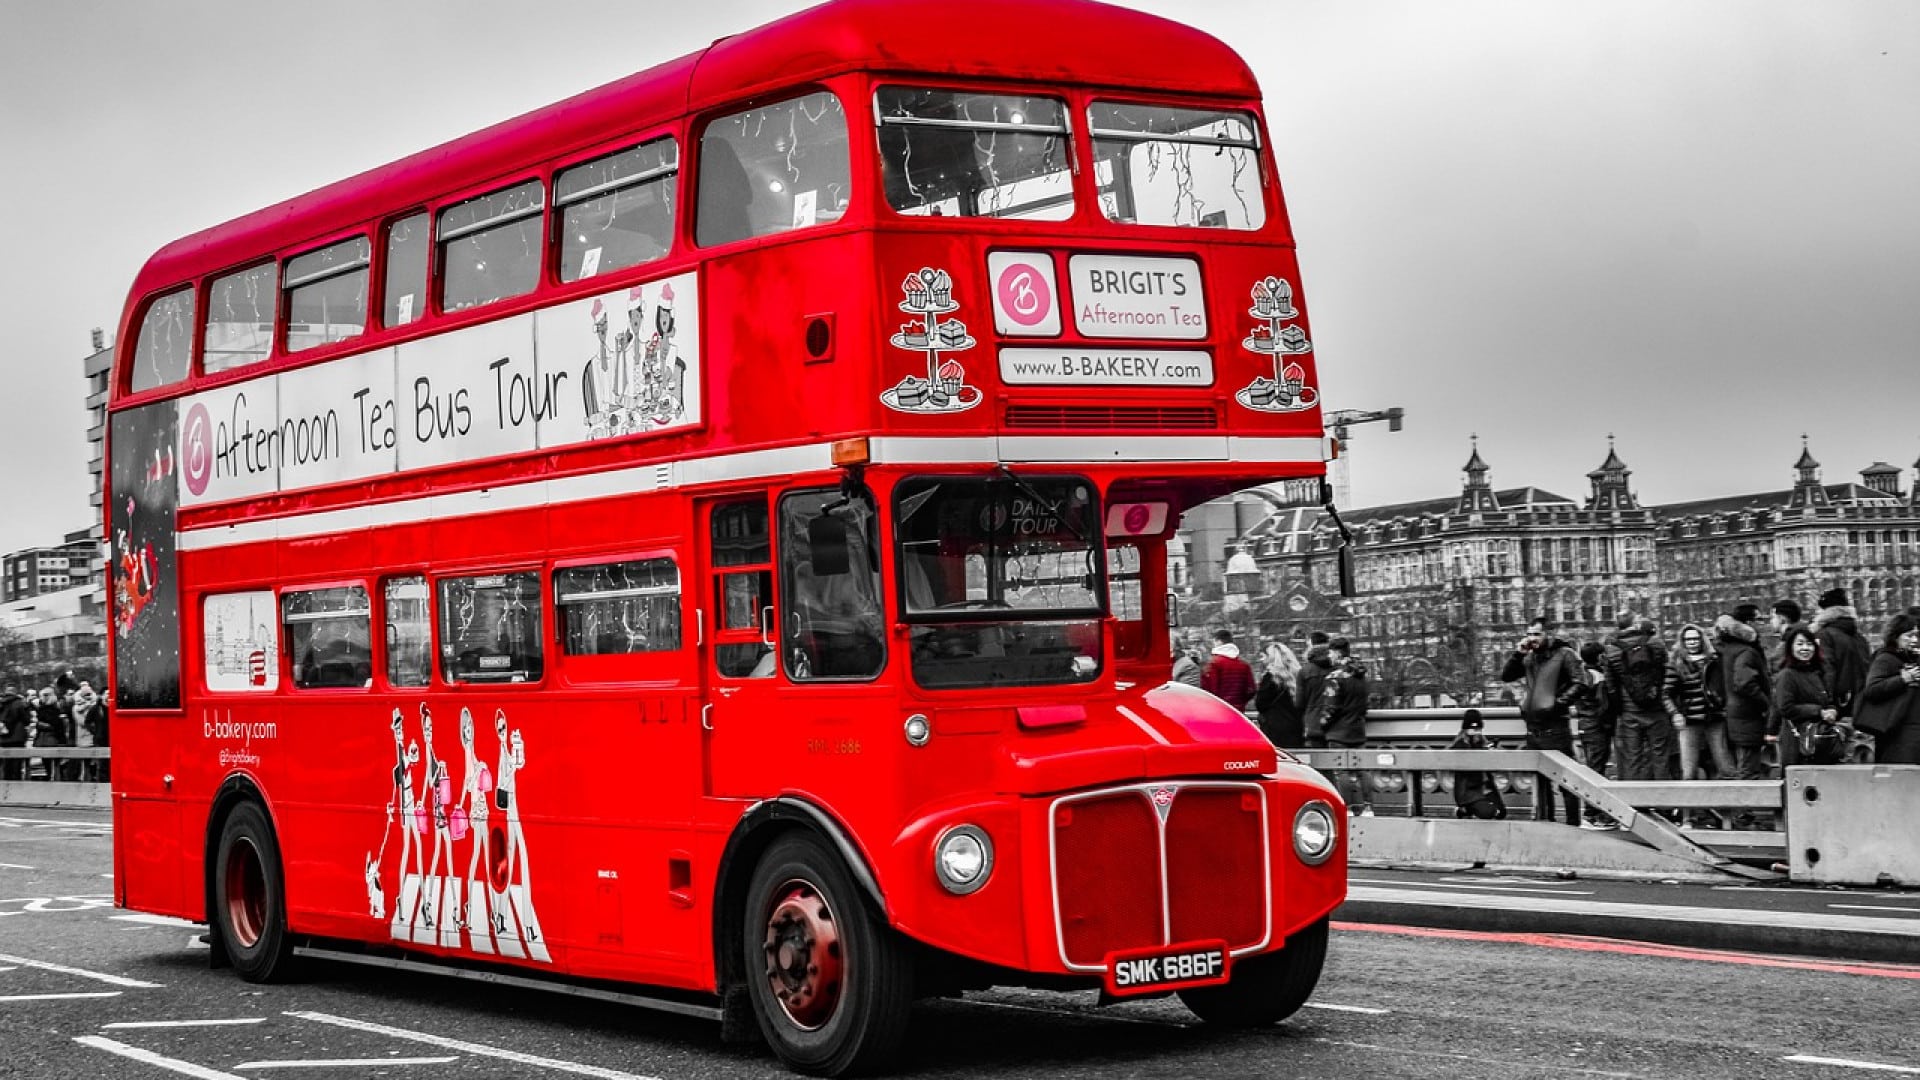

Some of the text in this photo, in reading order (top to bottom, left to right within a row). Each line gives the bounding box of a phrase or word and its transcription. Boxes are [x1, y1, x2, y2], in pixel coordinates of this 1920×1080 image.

[1089, 269, 1187, 297] BRIGIT'S
[1081, 302, 1203, 327] Afternoon Tea
[1013, 356, 1202, 379] www.B-BAKERY.com
[215, 356, 568, 478] Afternoon Tea Bus Tour
[1011, 499, 1063, 517] DAILY
[1011, 518, 1059, 535] TOUR
[203, 708, 277, 748] b-bakery.com
[807, 737, 831, 755] RM
[1223, 759, 1260, 771] COOLANT
[1115, 951, 1222, 986] SMK 686F
